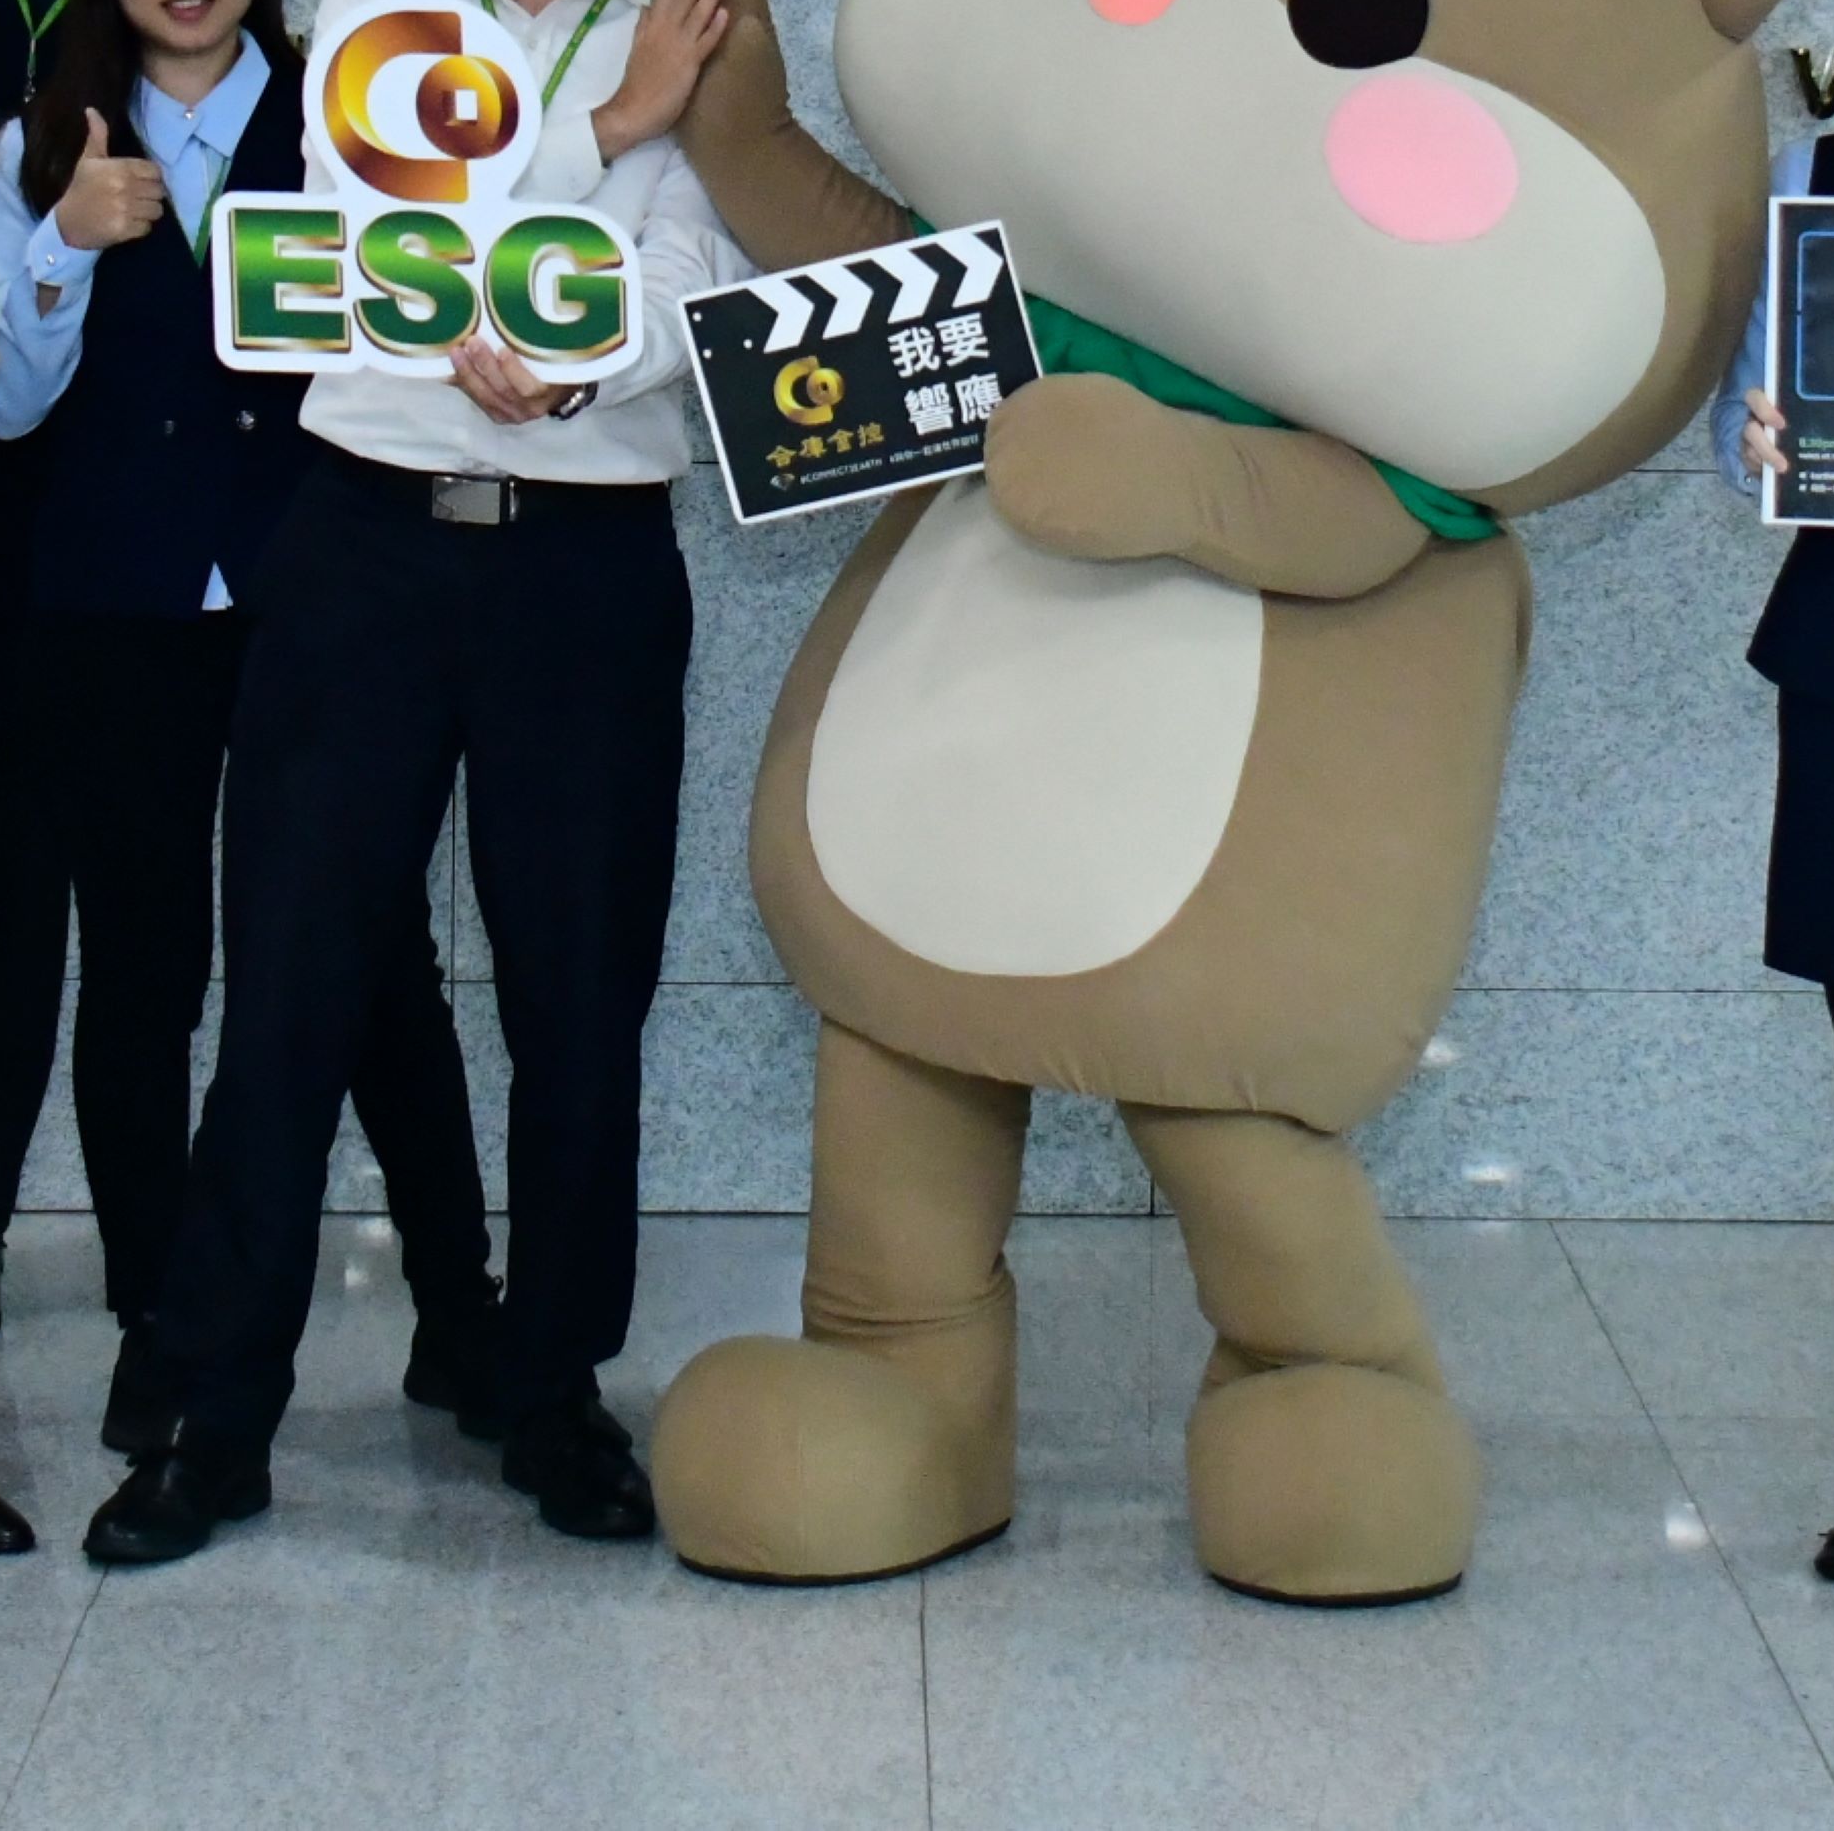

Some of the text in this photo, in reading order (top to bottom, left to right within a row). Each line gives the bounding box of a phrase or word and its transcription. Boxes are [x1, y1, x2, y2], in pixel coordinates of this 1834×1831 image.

[229, 206, 628, 364] ESG
[887, 312, 991, 378] 我要
[904, 372, 1003, 436] 響應
